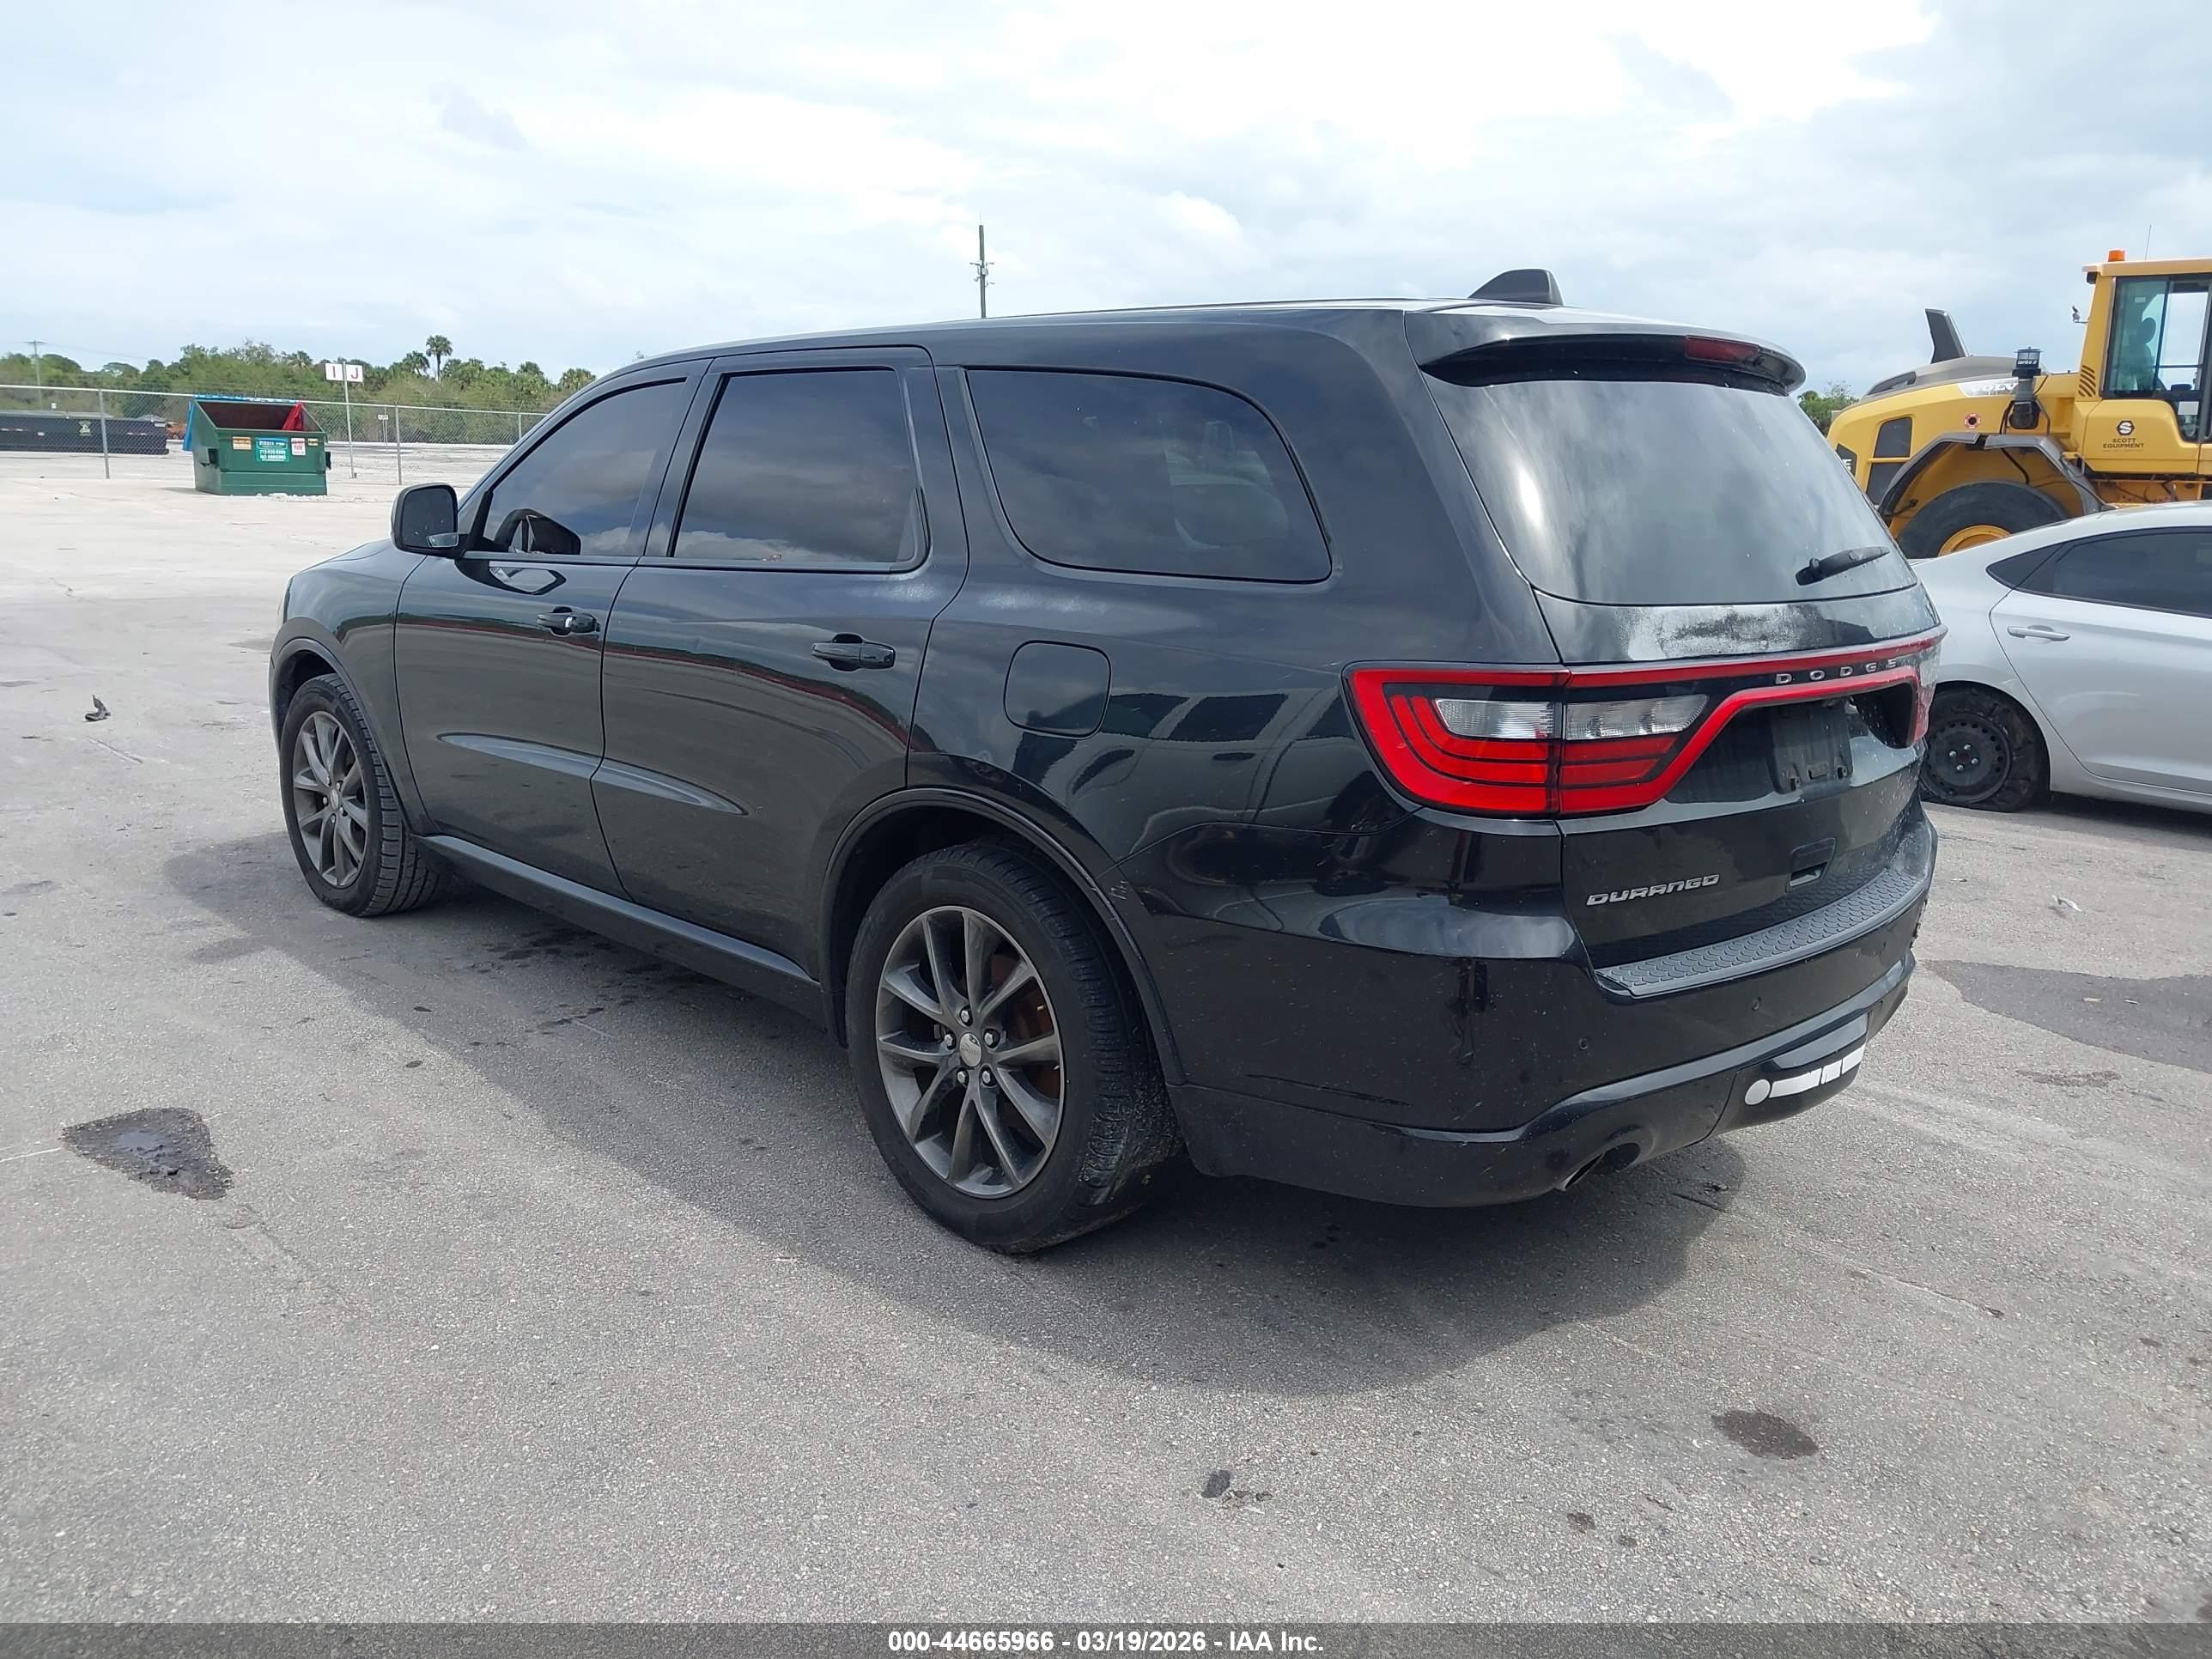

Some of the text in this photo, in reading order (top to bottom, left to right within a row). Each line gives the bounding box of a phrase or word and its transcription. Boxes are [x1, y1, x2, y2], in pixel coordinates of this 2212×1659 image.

[350, 367, 359, 380] J
[1774, 659, 1897, 685] DODGE
[1586, 874, 1720, 906] DURANGO
